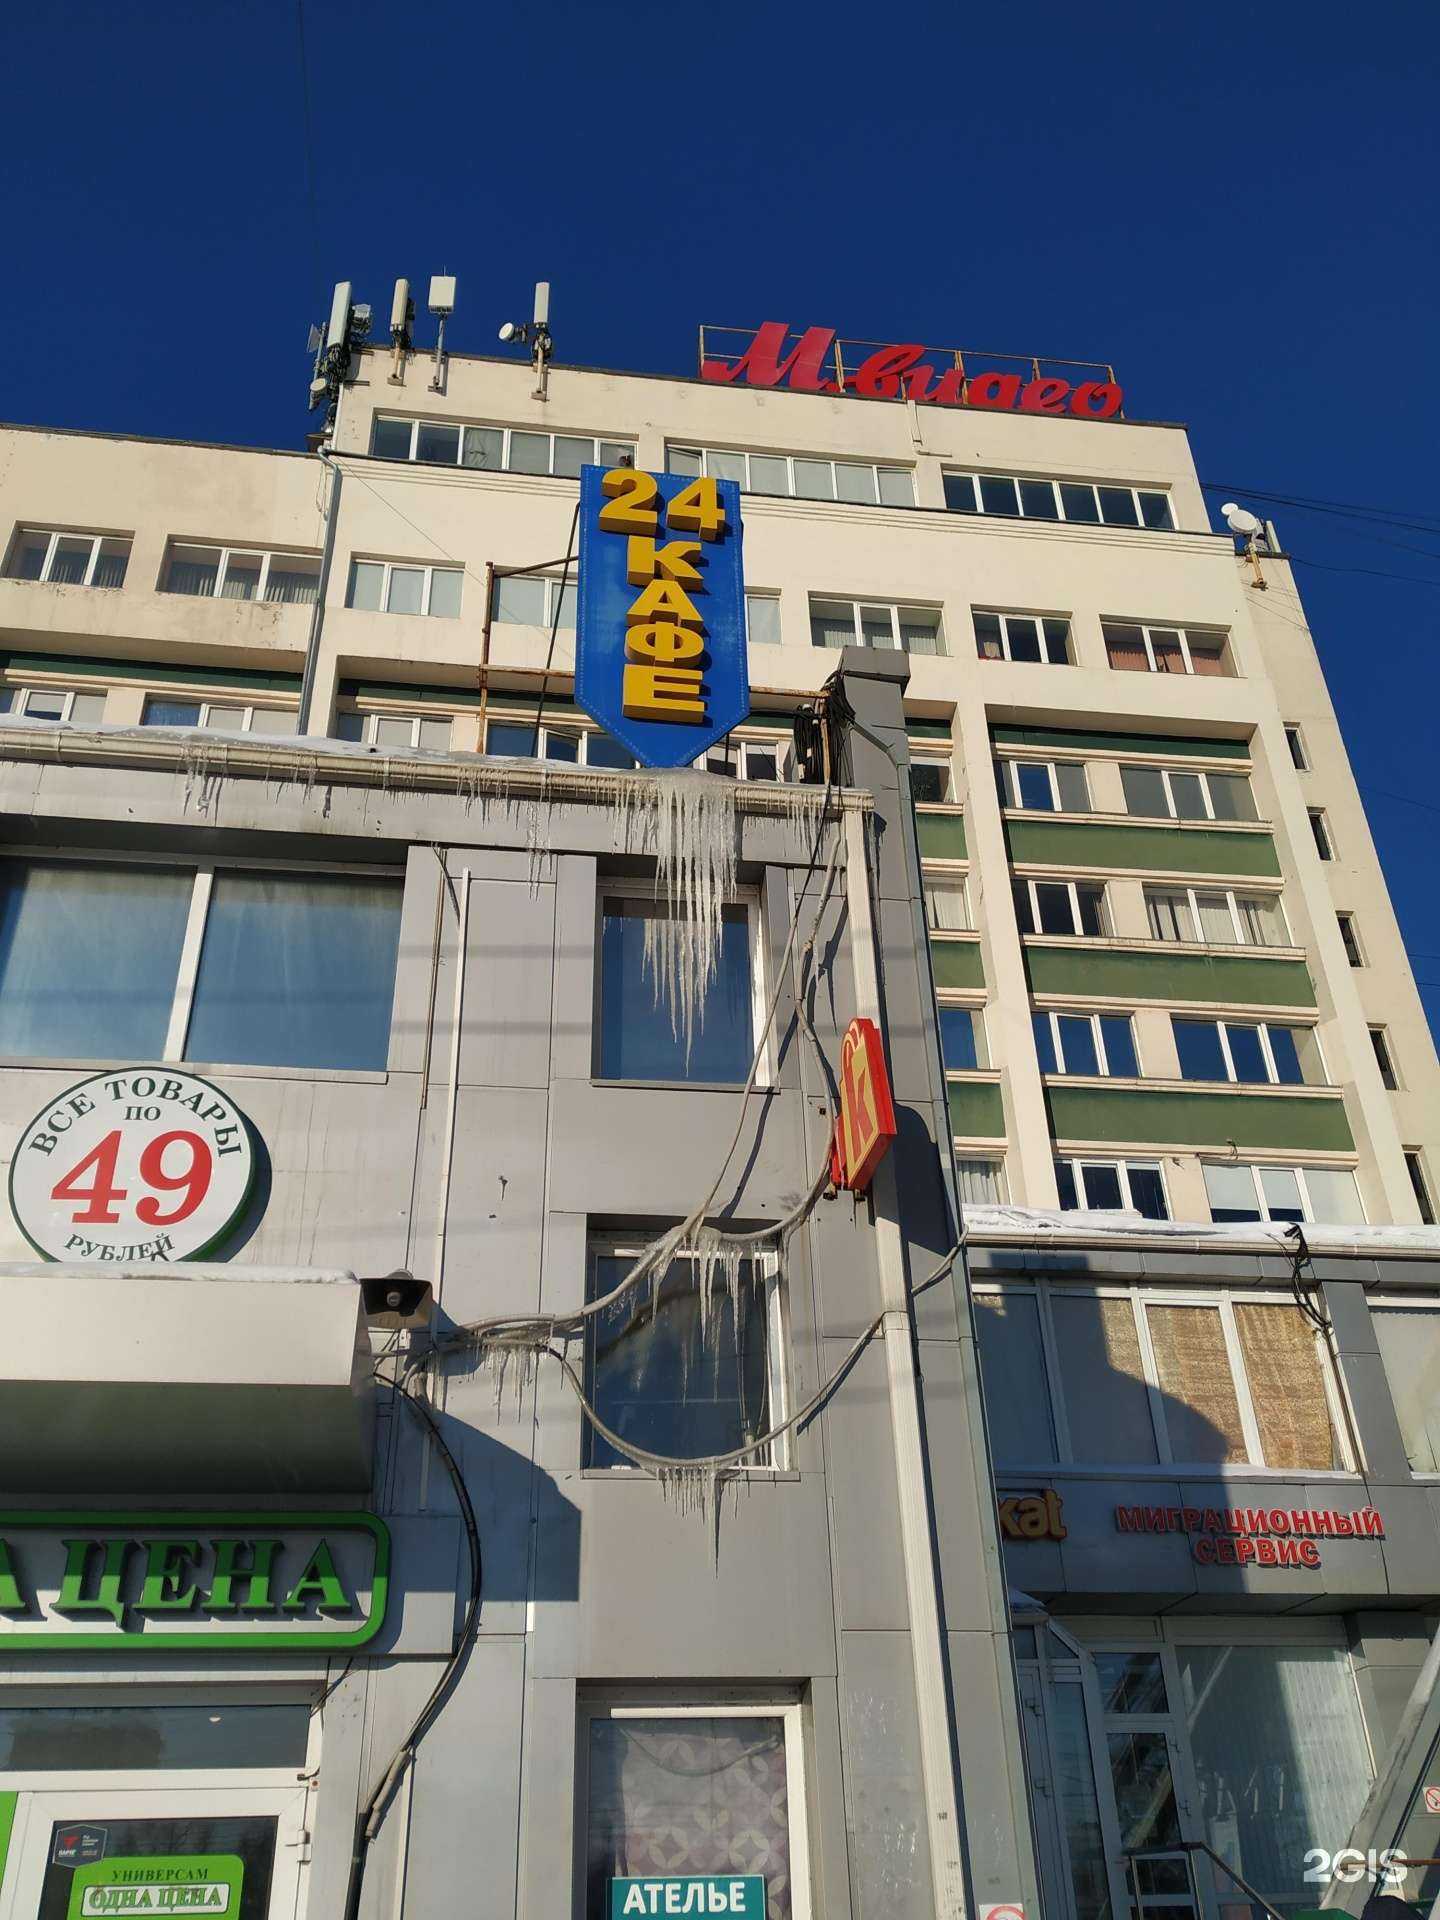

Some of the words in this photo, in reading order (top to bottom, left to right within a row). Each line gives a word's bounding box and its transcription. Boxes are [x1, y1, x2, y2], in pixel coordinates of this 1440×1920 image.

[599, 469, 725, 541] 24
[622, 535, 705, 724] КАФЕ
[28, 1092, 96, 1157] ВСЕ
[104, 1076, 242, 1158] ТОВАРЫ
[123, 1106, 161, 1121] ПО
[50, 1130, 213, 1226] 49
[64, 1232, 175, 1262] РУБЛЕЙ
[1116, 1504, 1385, 1538] МИГРАЦИОННЫЙ
[1194, 1538, 1321, 1568] СЕРВИС
[49, 1538, 352, 1627] ЦЕНА
[112, 1868, 208, 1881] УНИВЕРСАМ
[89, 1886, 152, 1913] ОДНА
[156, 1886, 223, 1912] ЦЕНА
[622, 1881, 747, 1915] АТЕЛЬЕ
